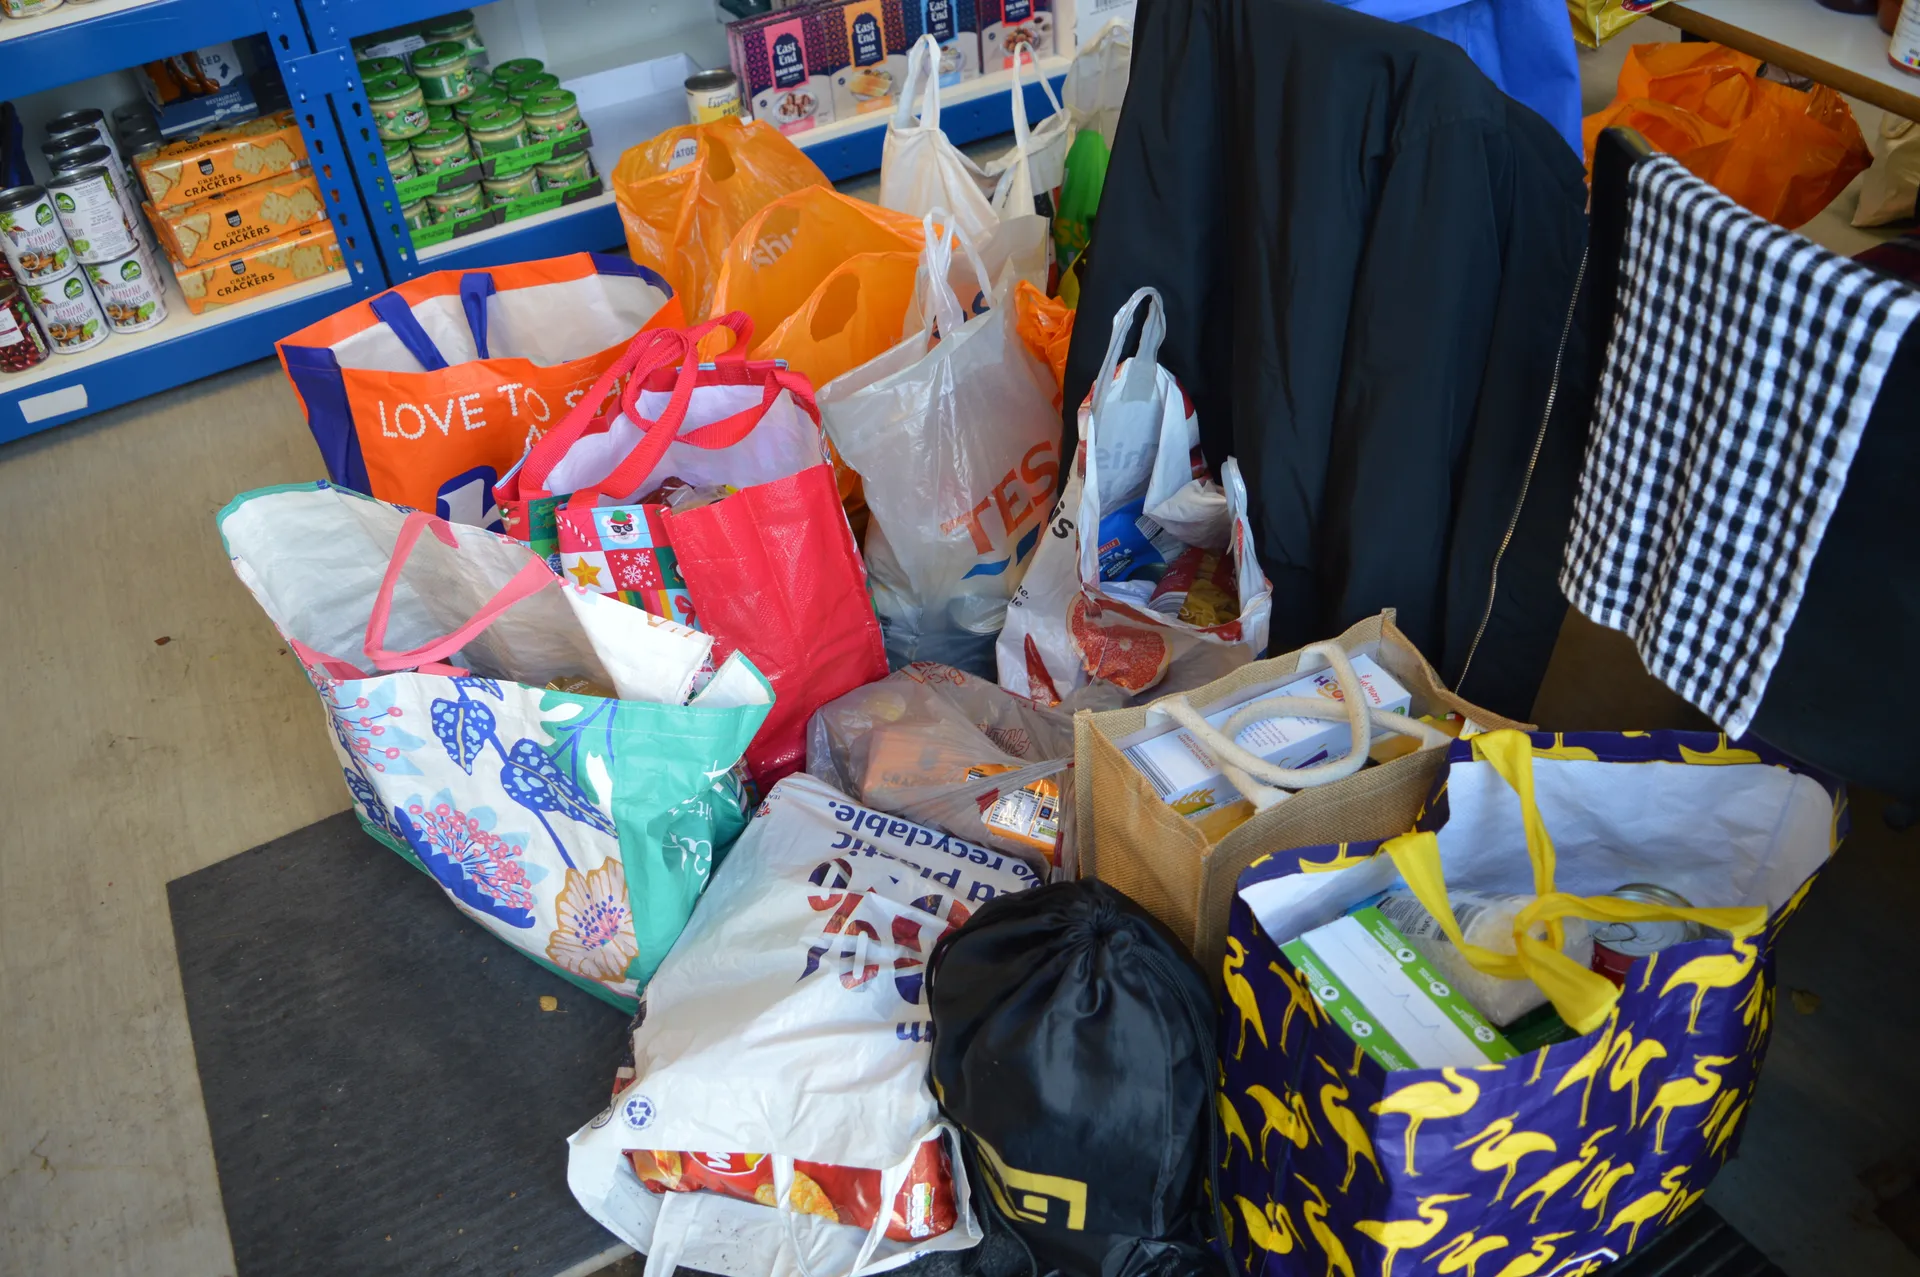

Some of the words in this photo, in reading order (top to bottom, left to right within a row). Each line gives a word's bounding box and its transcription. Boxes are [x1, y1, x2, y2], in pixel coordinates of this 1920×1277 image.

[931, 9, 948, 22] End
[855, 21, 875, 33] East
[857, 32, 876, 44] End
[776, 42, 796, 56] East
[779, 53, 797, 66] End
[205, 92, 240, 106] RESTAURANT
[216, 96, 242, 108] INSPIRED
[673, 146, 697, 159] ATOE
[184, 174, 243, 198] CRACKERS
[198, 174, 225, 186] CREAM
[213, 225, 271, 251] CRACKERS
[226, 225, 253, 238] CREAM
[217, 272, 276, 297] CRACKERS
[230, 273, 257, 285] CREAM
[378, 393, 487, 440] LOVE
[497, 382, 551, 422] TO
[940, 440, 1062, 556] TES
[1313, 675, 1346, 703] HOO
[828, 799, 1005, 872] recyclable.
